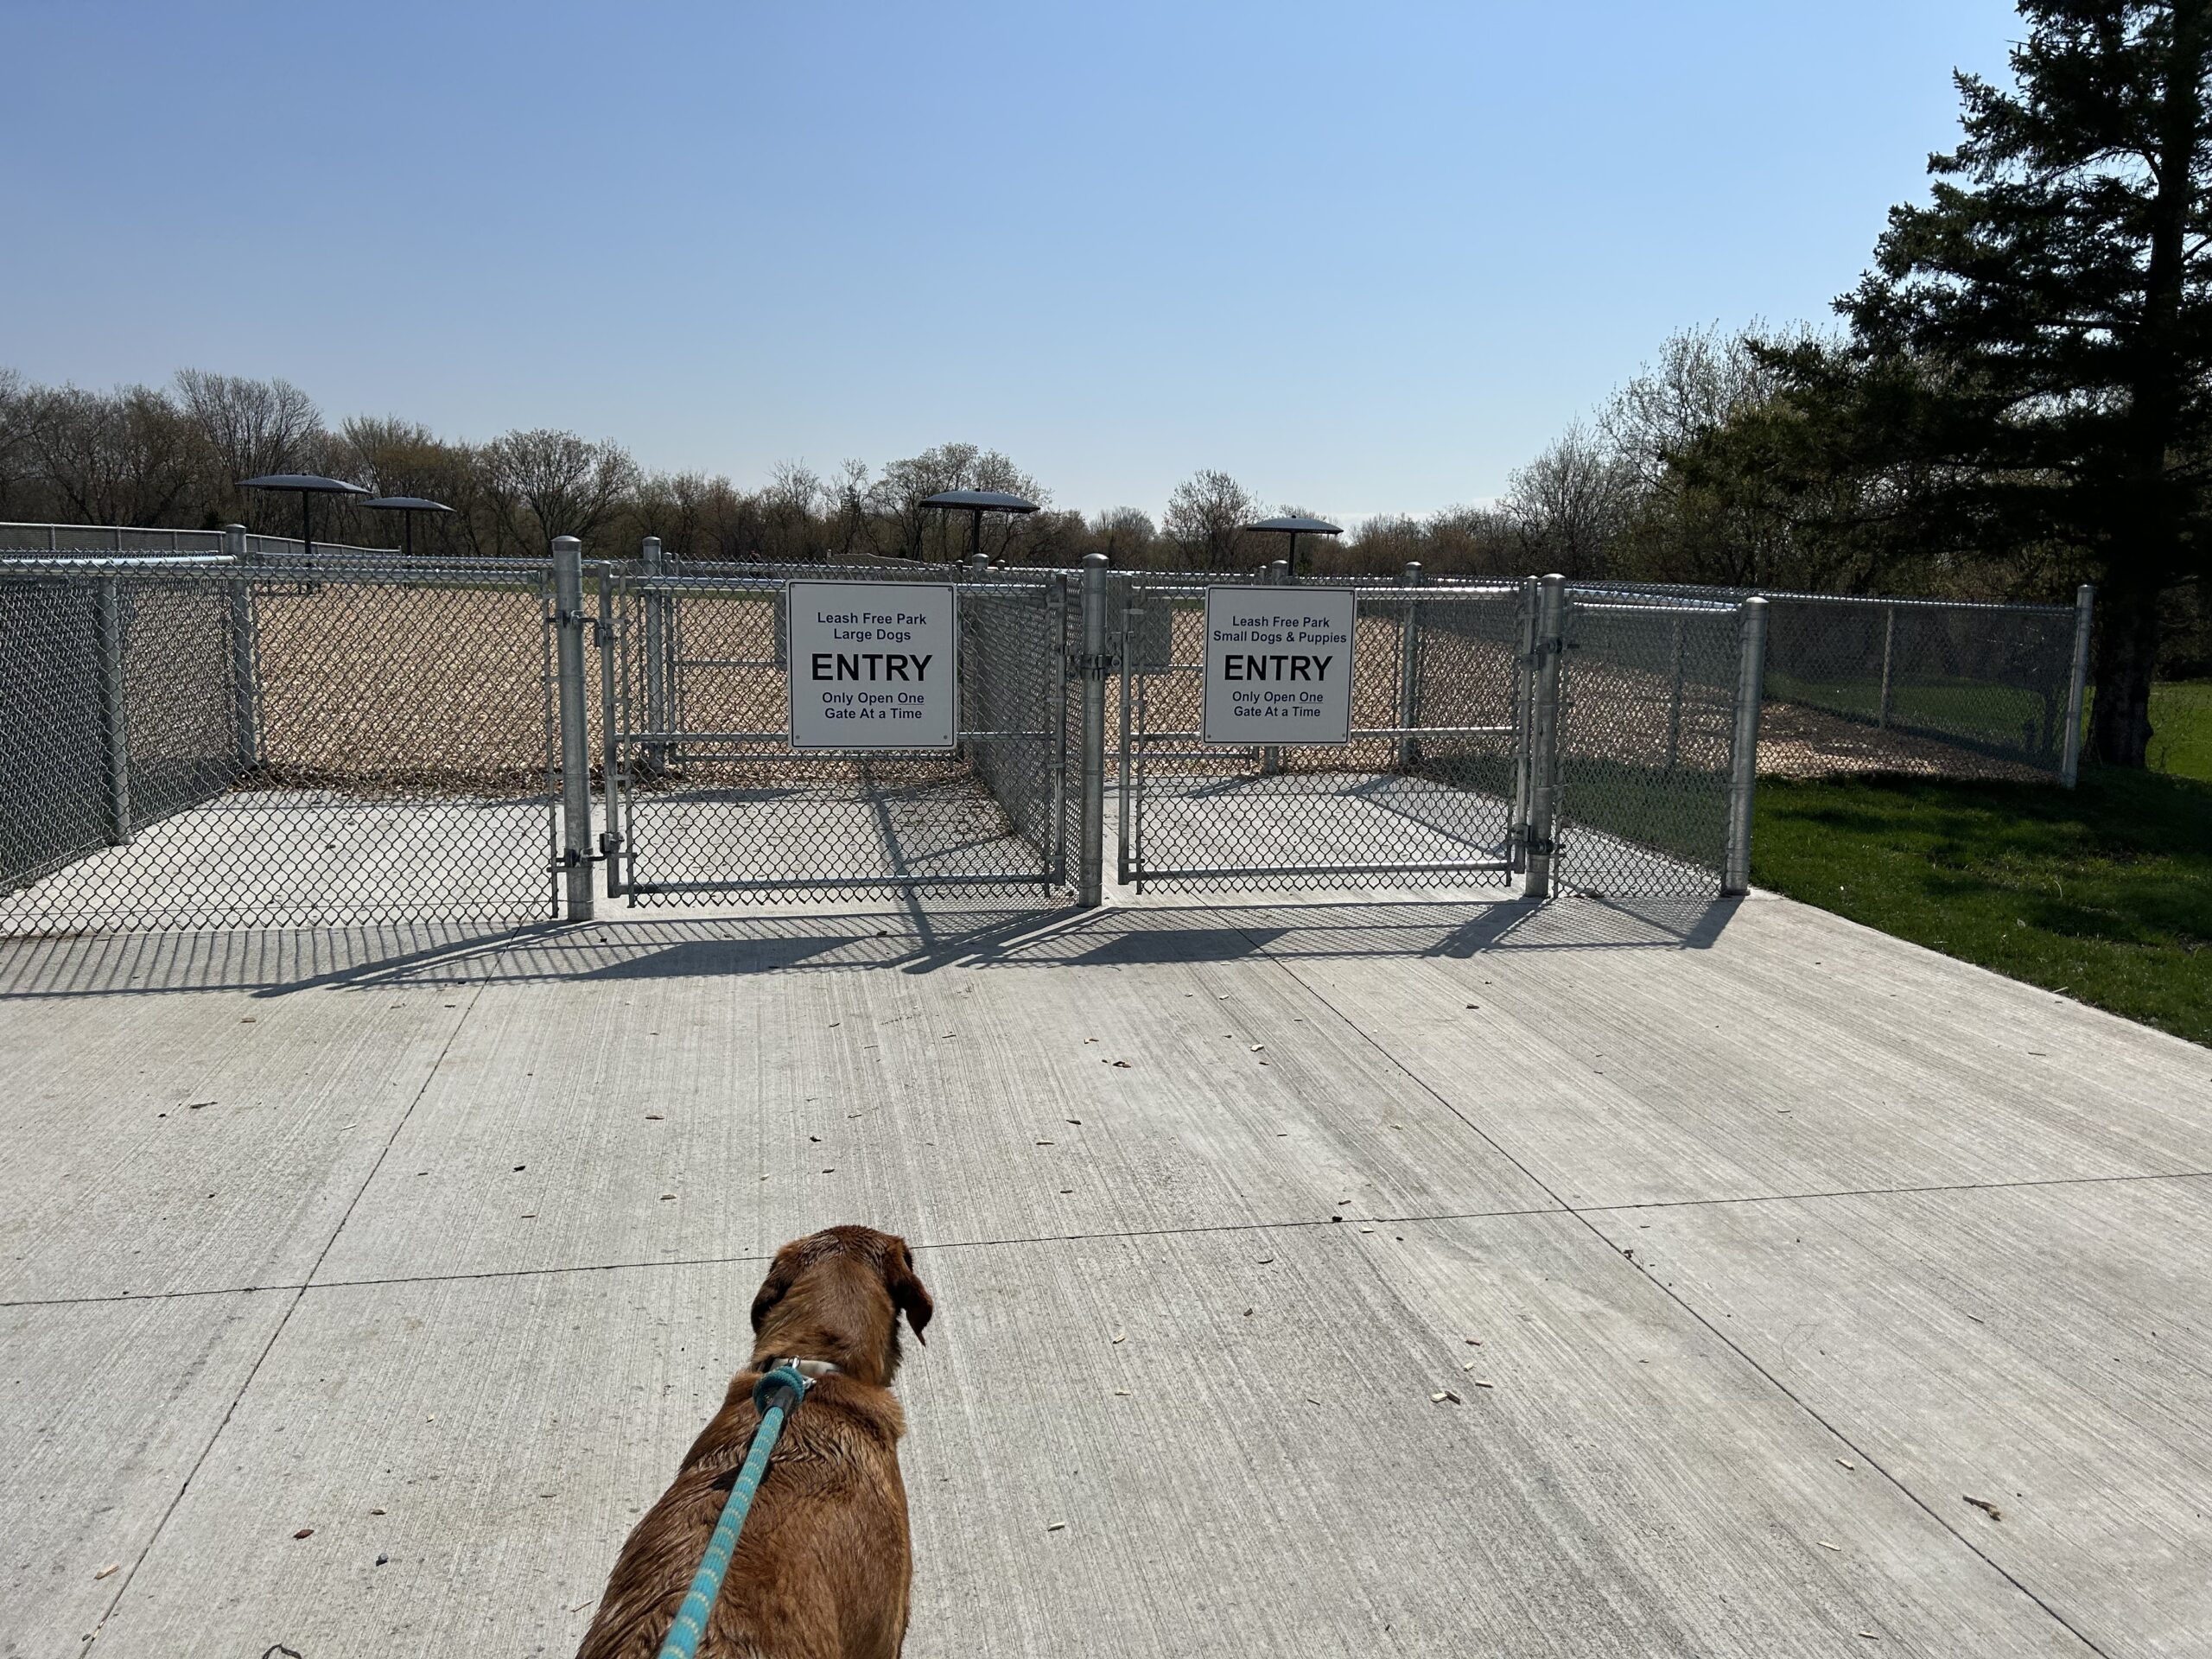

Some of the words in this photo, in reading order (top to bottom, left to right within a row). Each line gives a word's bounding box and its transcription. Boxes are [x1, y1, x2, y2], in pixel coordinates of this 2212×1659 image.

[817, 612, 858, 624] Leash
[862, 613, 893, 624] Free
[897, 613, 927, 625] Park
[1232, 616, 1269, 627] Leash
[1273, 616, 1300, 627] Free
[1303, 617, 1330, 628] Park
[834, 628, 872, 642] Large
[876, 629, 912, 643] Dogs
[1213, 631, 1248, 642] Small
[1251, 632, 1282, 645] Dogs
[1286, 632, 1295, 643] &
[1299, 632, 1347, 645] Puppies
[811, 653, 933, 681] ENTRY
[1224, 655, 1333, 681] ENTRY
[822, 692, 854, 706] Only
[858, 692, 893, 706] Open
[898, 692, 925, 703] One
[1232, 691, 1261, 704] Only
[1263, 691, 1296, 704] Open
[1300, 691, 1324, 702] One
[824, 708, 856, 719] Gate
[860, 708, 874, 719] At
[878, 710, 887, 719] a
[890, 708, 922, 719] Time
[1234, 706, 1262, 717] Gate
[1264, 707, 1278, 717] At
[1293, 707, 1321, 717] Time
